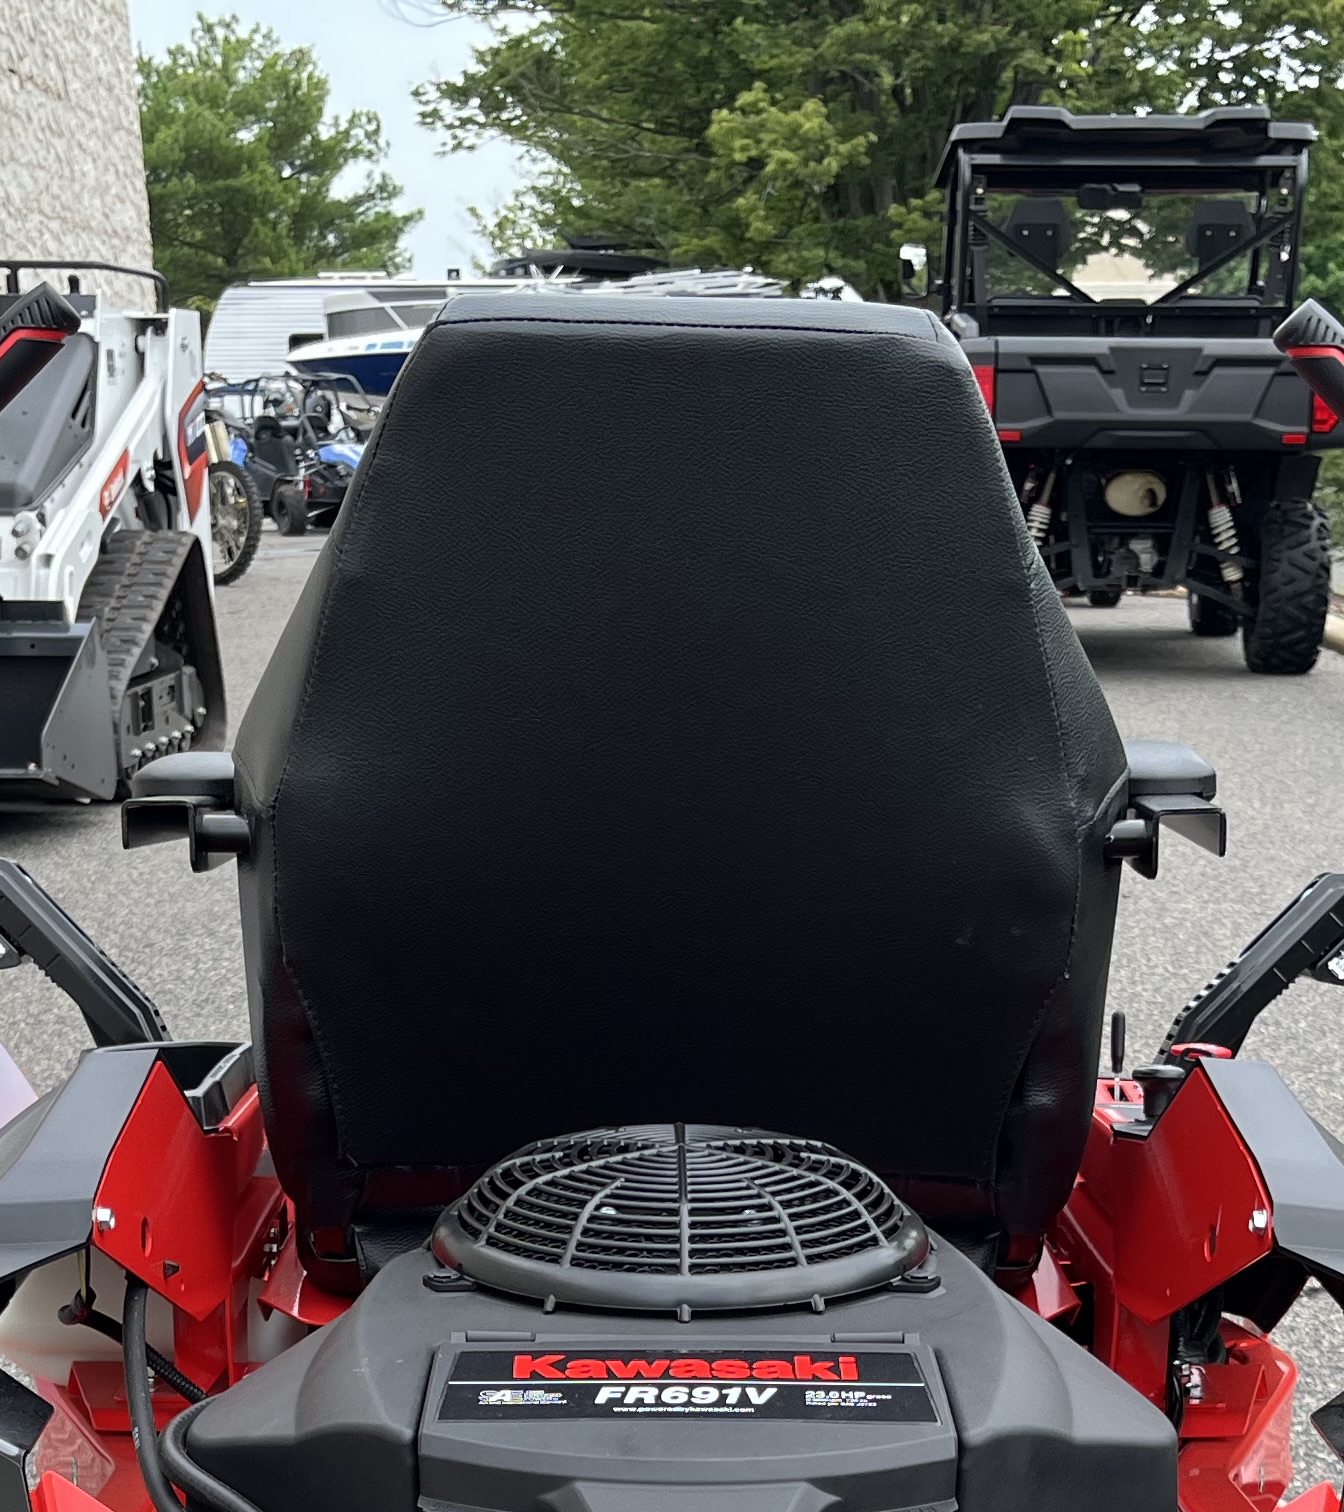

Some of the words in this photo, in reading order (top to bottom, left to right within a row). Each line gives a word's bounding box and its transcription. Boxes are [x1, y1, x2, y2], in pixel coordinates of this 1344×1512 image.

[512, 1354, 859, 1380] Kawasaki
[594, 1386, 777, 1405] FR691V
[840, 1391, 865, 1399] HP
